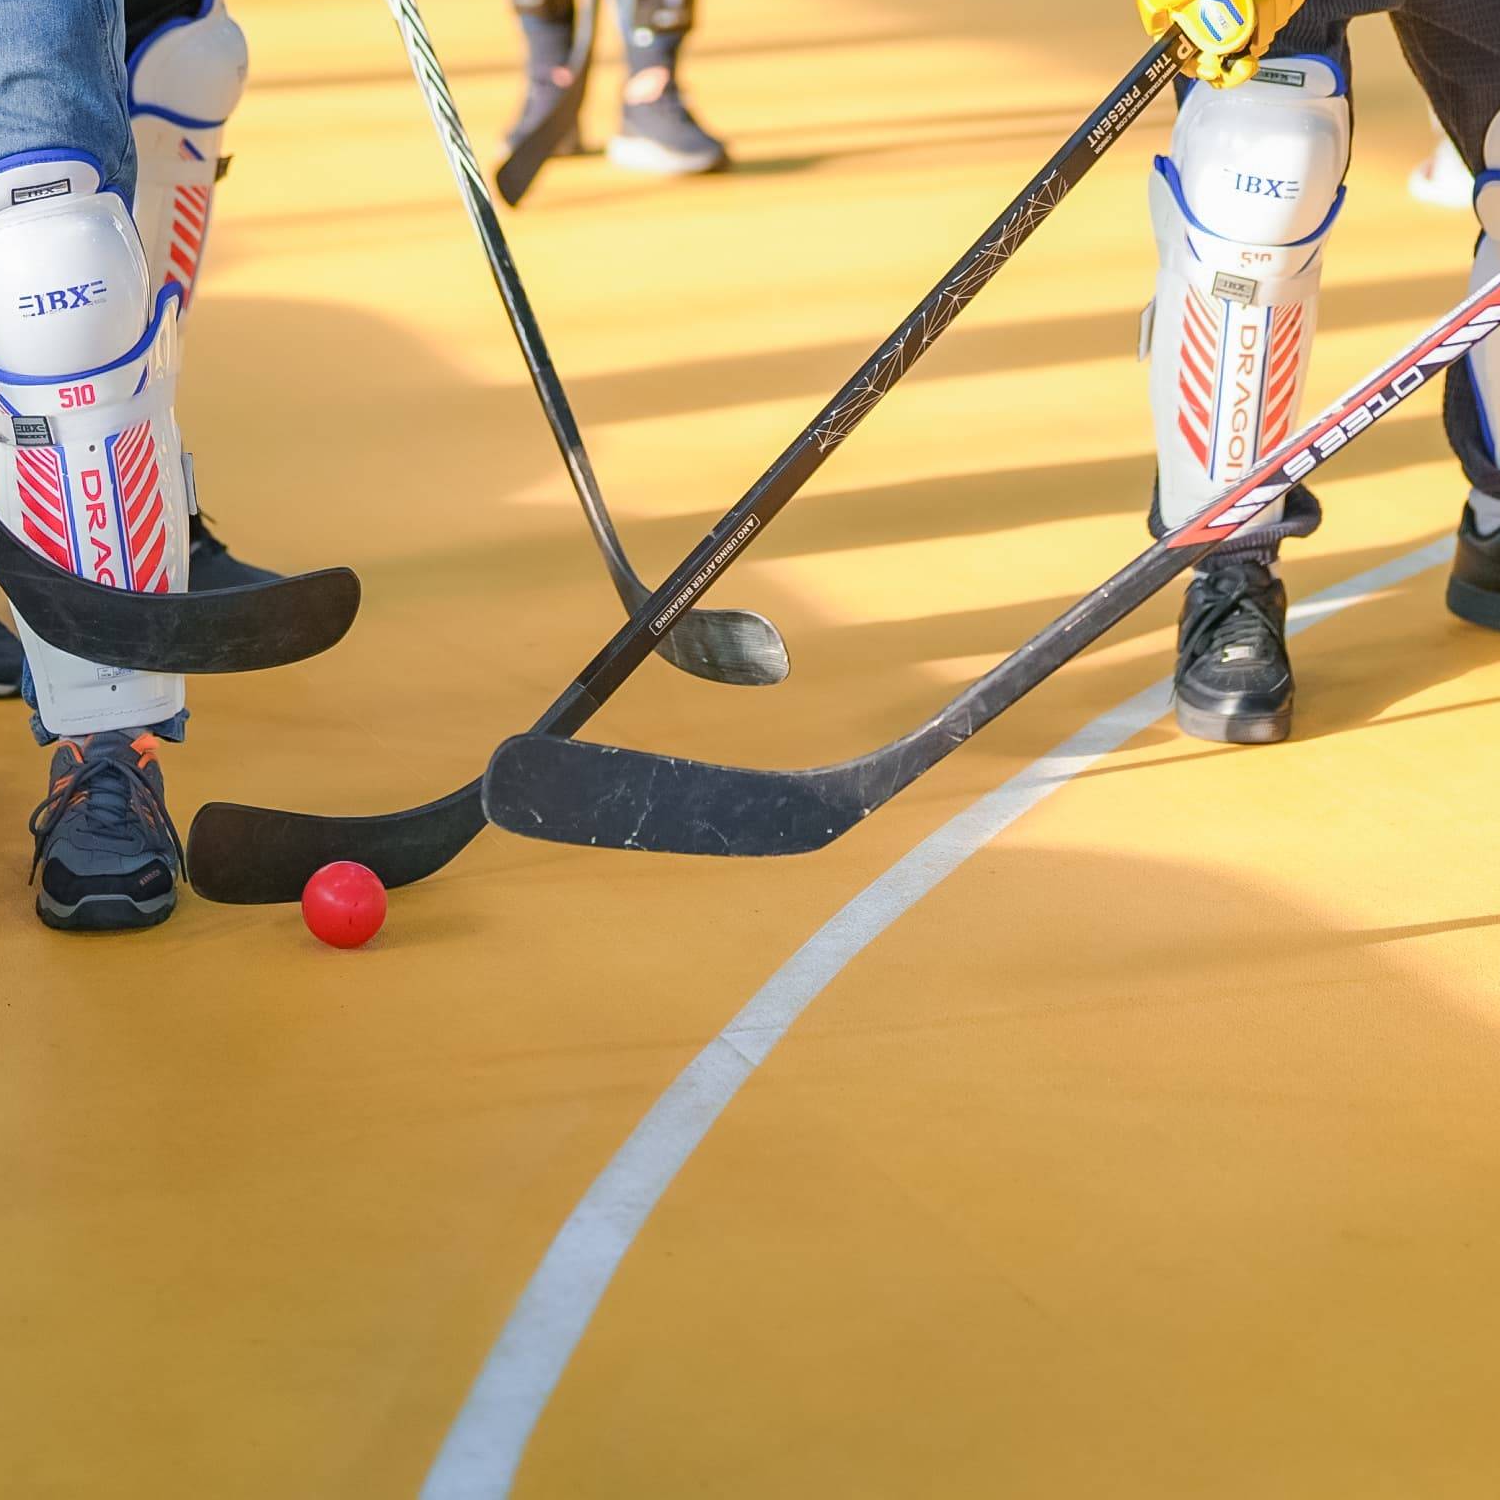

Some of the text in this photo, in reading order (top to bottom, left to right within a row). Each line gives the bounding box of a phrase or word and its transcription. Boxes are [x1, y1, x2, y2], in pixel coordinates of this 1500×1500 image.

[1087, 53, 1171, 148] THE PRESENT
[58, 384, 96, 409] 510
[654, 525, 750, 629] NO USING AFTER BREAKING
